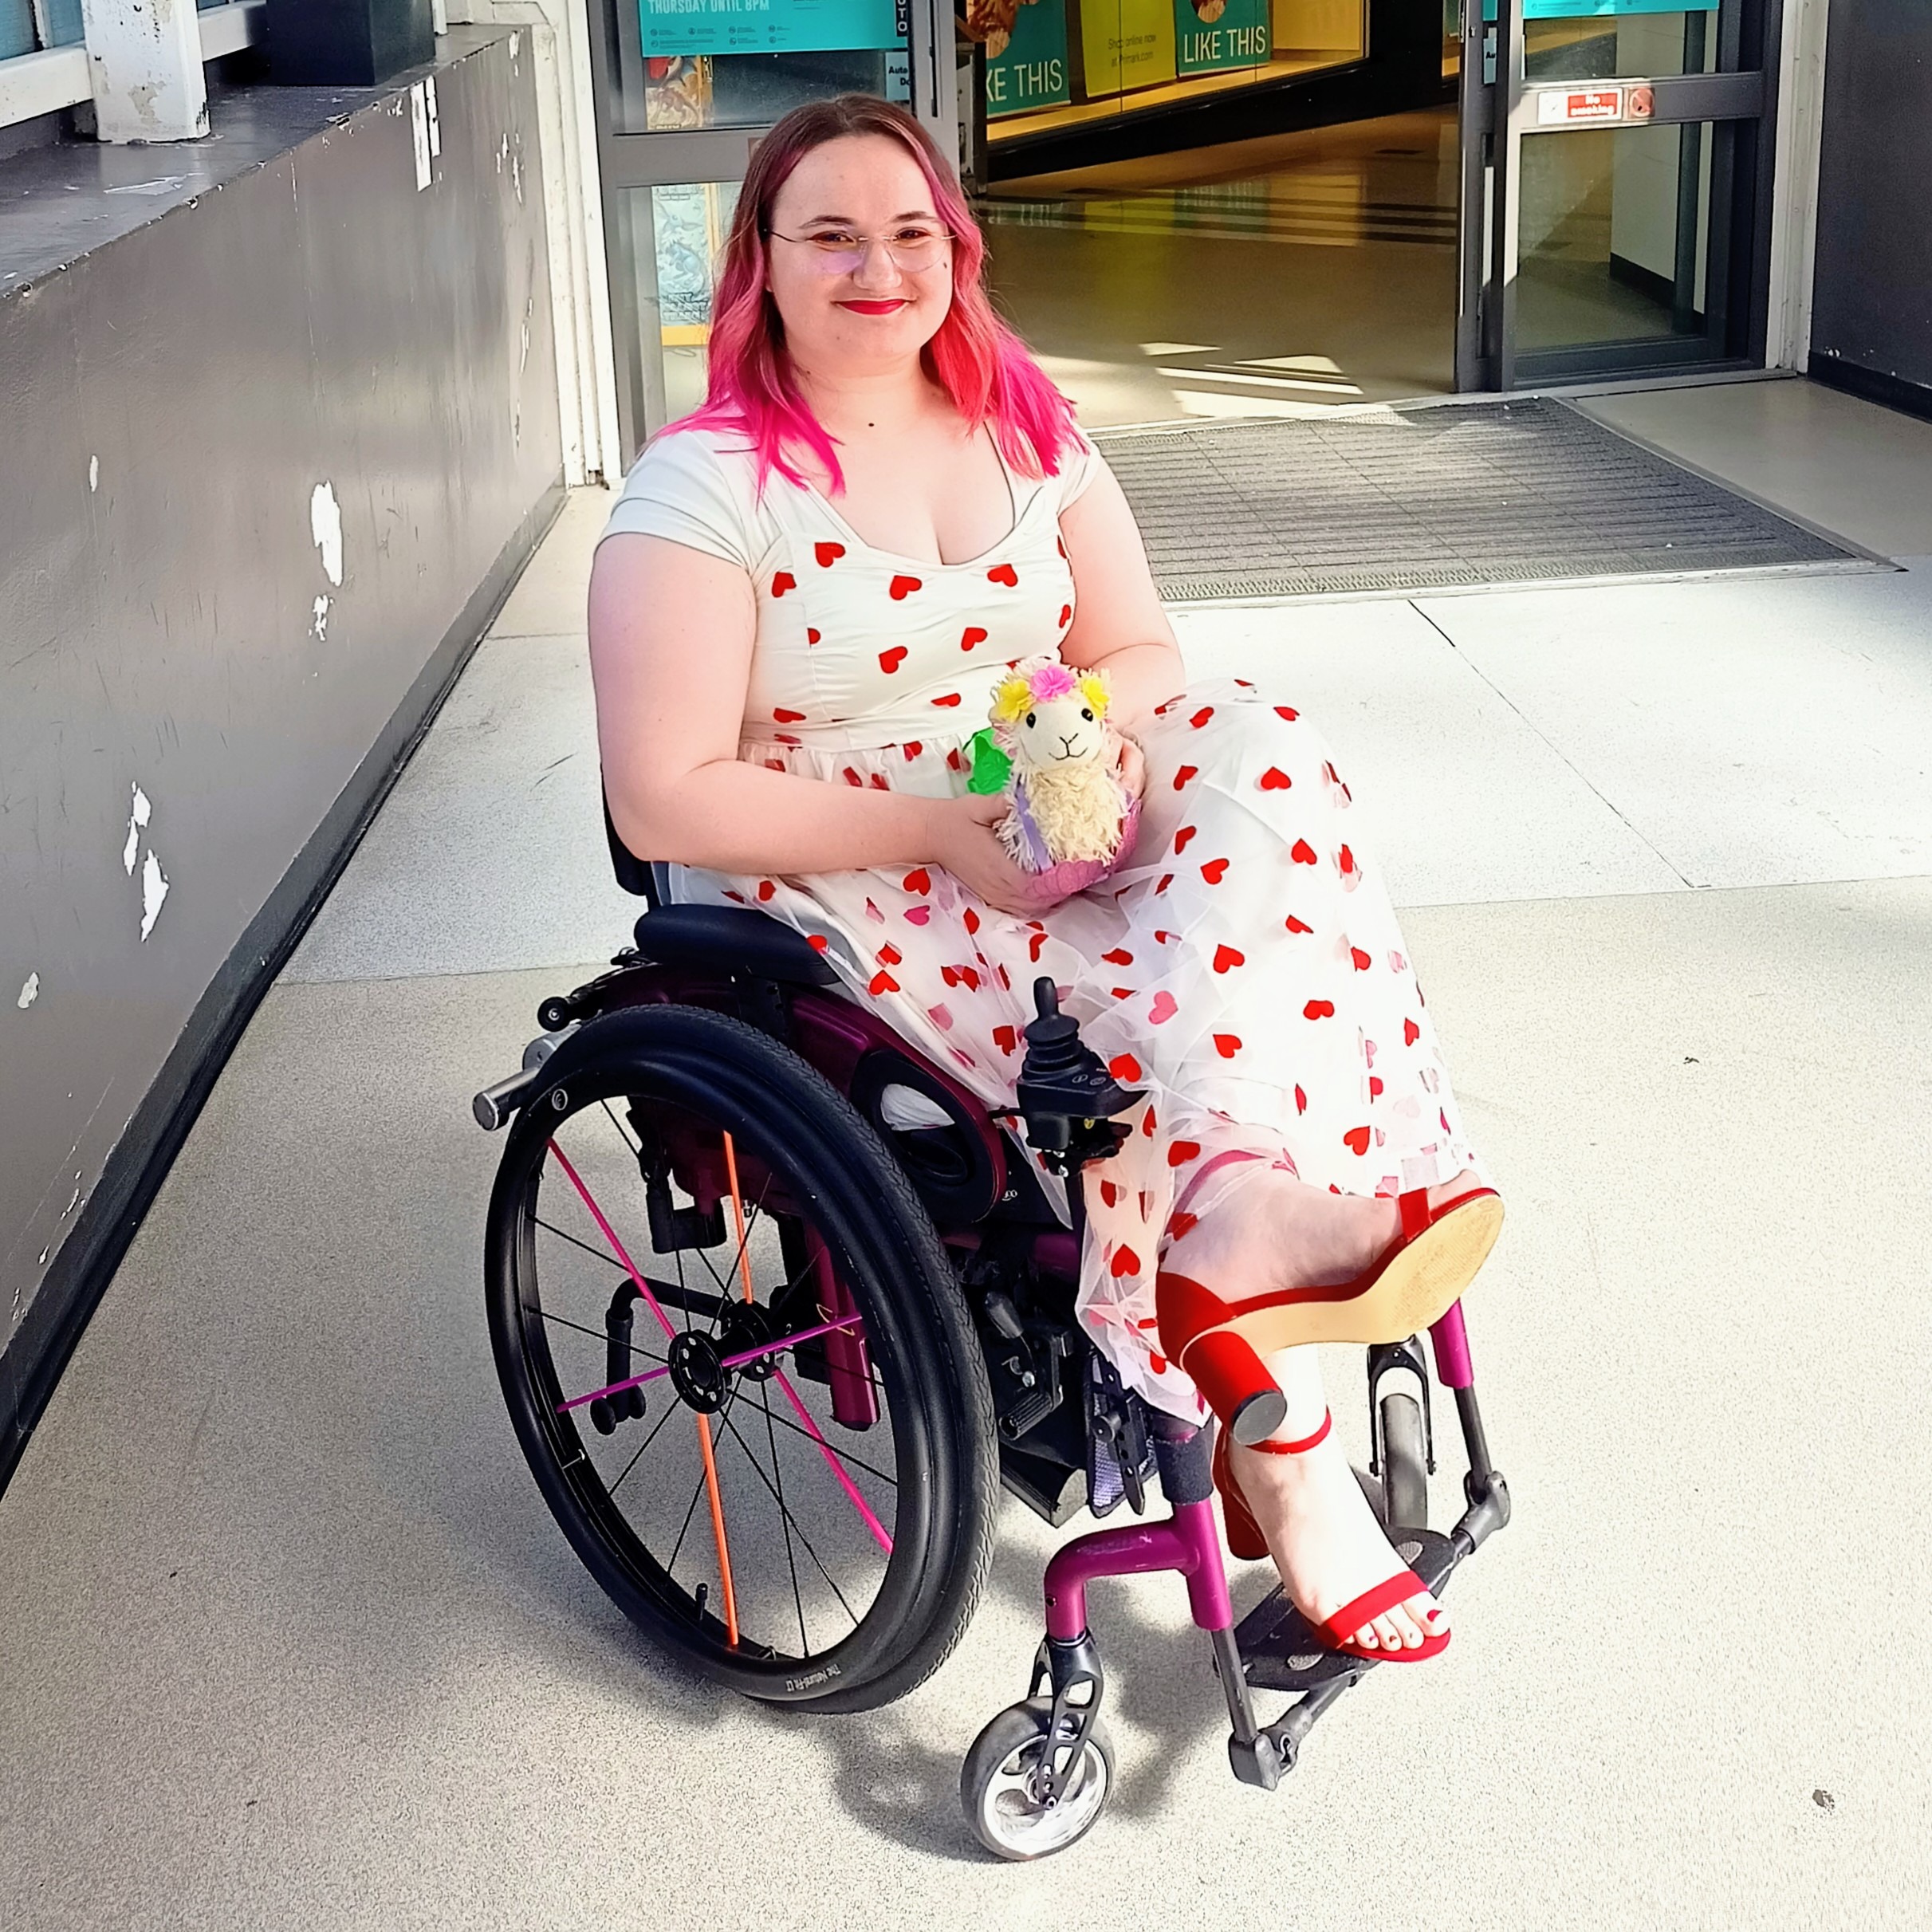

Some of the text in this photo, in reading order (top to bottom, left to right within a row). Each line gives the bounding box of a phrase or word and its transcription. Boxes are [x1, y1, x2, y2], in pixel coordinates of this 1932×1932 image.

[648, 0, 769, 14] THURSDAY UNTIL 8PM
[1184, 26, 1265, 63] LIKE THIS
[1013, 58, 1062, 97] THIS
[1585, 94, 1601, 105] No
[1570, 104, 1615, 116] smoking
